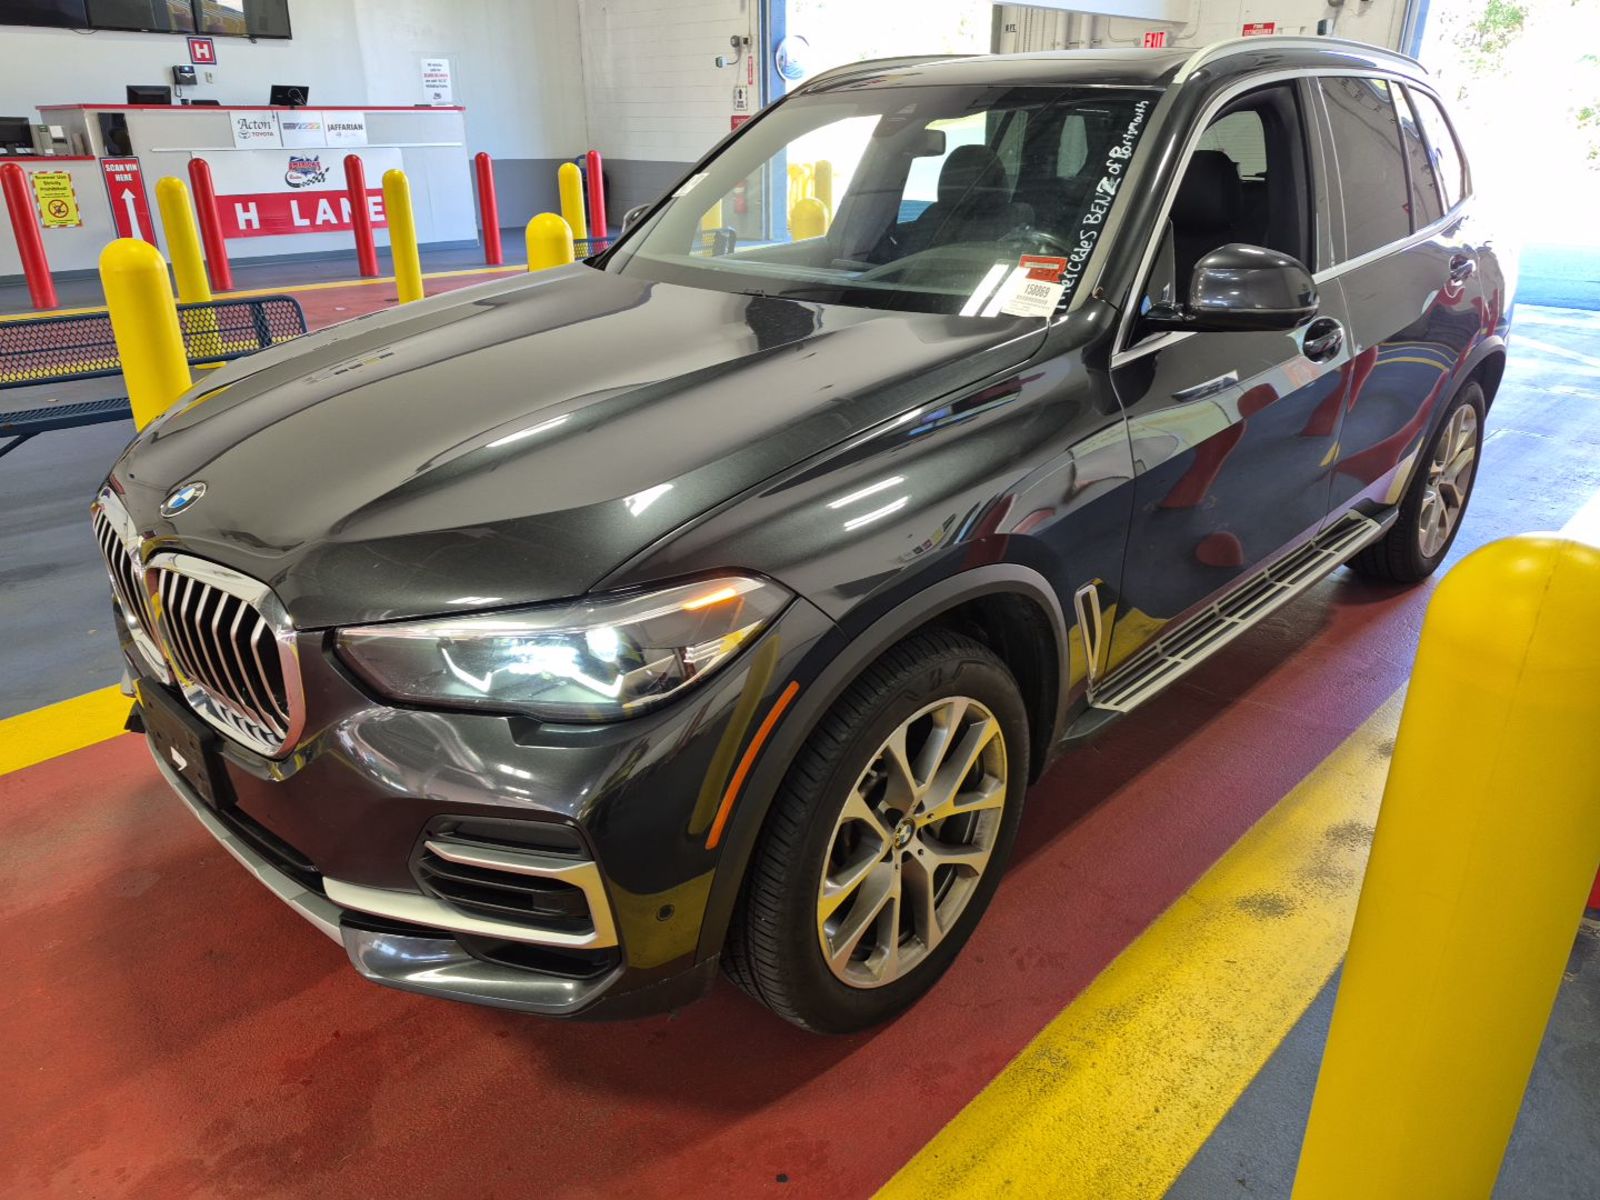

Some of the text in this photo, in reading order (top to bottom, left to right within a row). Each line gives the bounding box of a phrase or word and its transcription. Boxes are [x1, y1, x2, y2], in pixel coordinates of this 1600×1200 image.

[1144, 32, 1165, 48] EXIT
[193, 43, 210, 58] H
[238, 118, 271, 130] Acton
[327, 123, 364, 132] JAFFARIAN
[105, 163, 138, 172] SCAN VIN
[115, 173, 133, 181] HERE
[1083, 176, 1121, 225] BENZ
[1106, 159, 1123, 175] of
[234, 202, 261, 230] H
